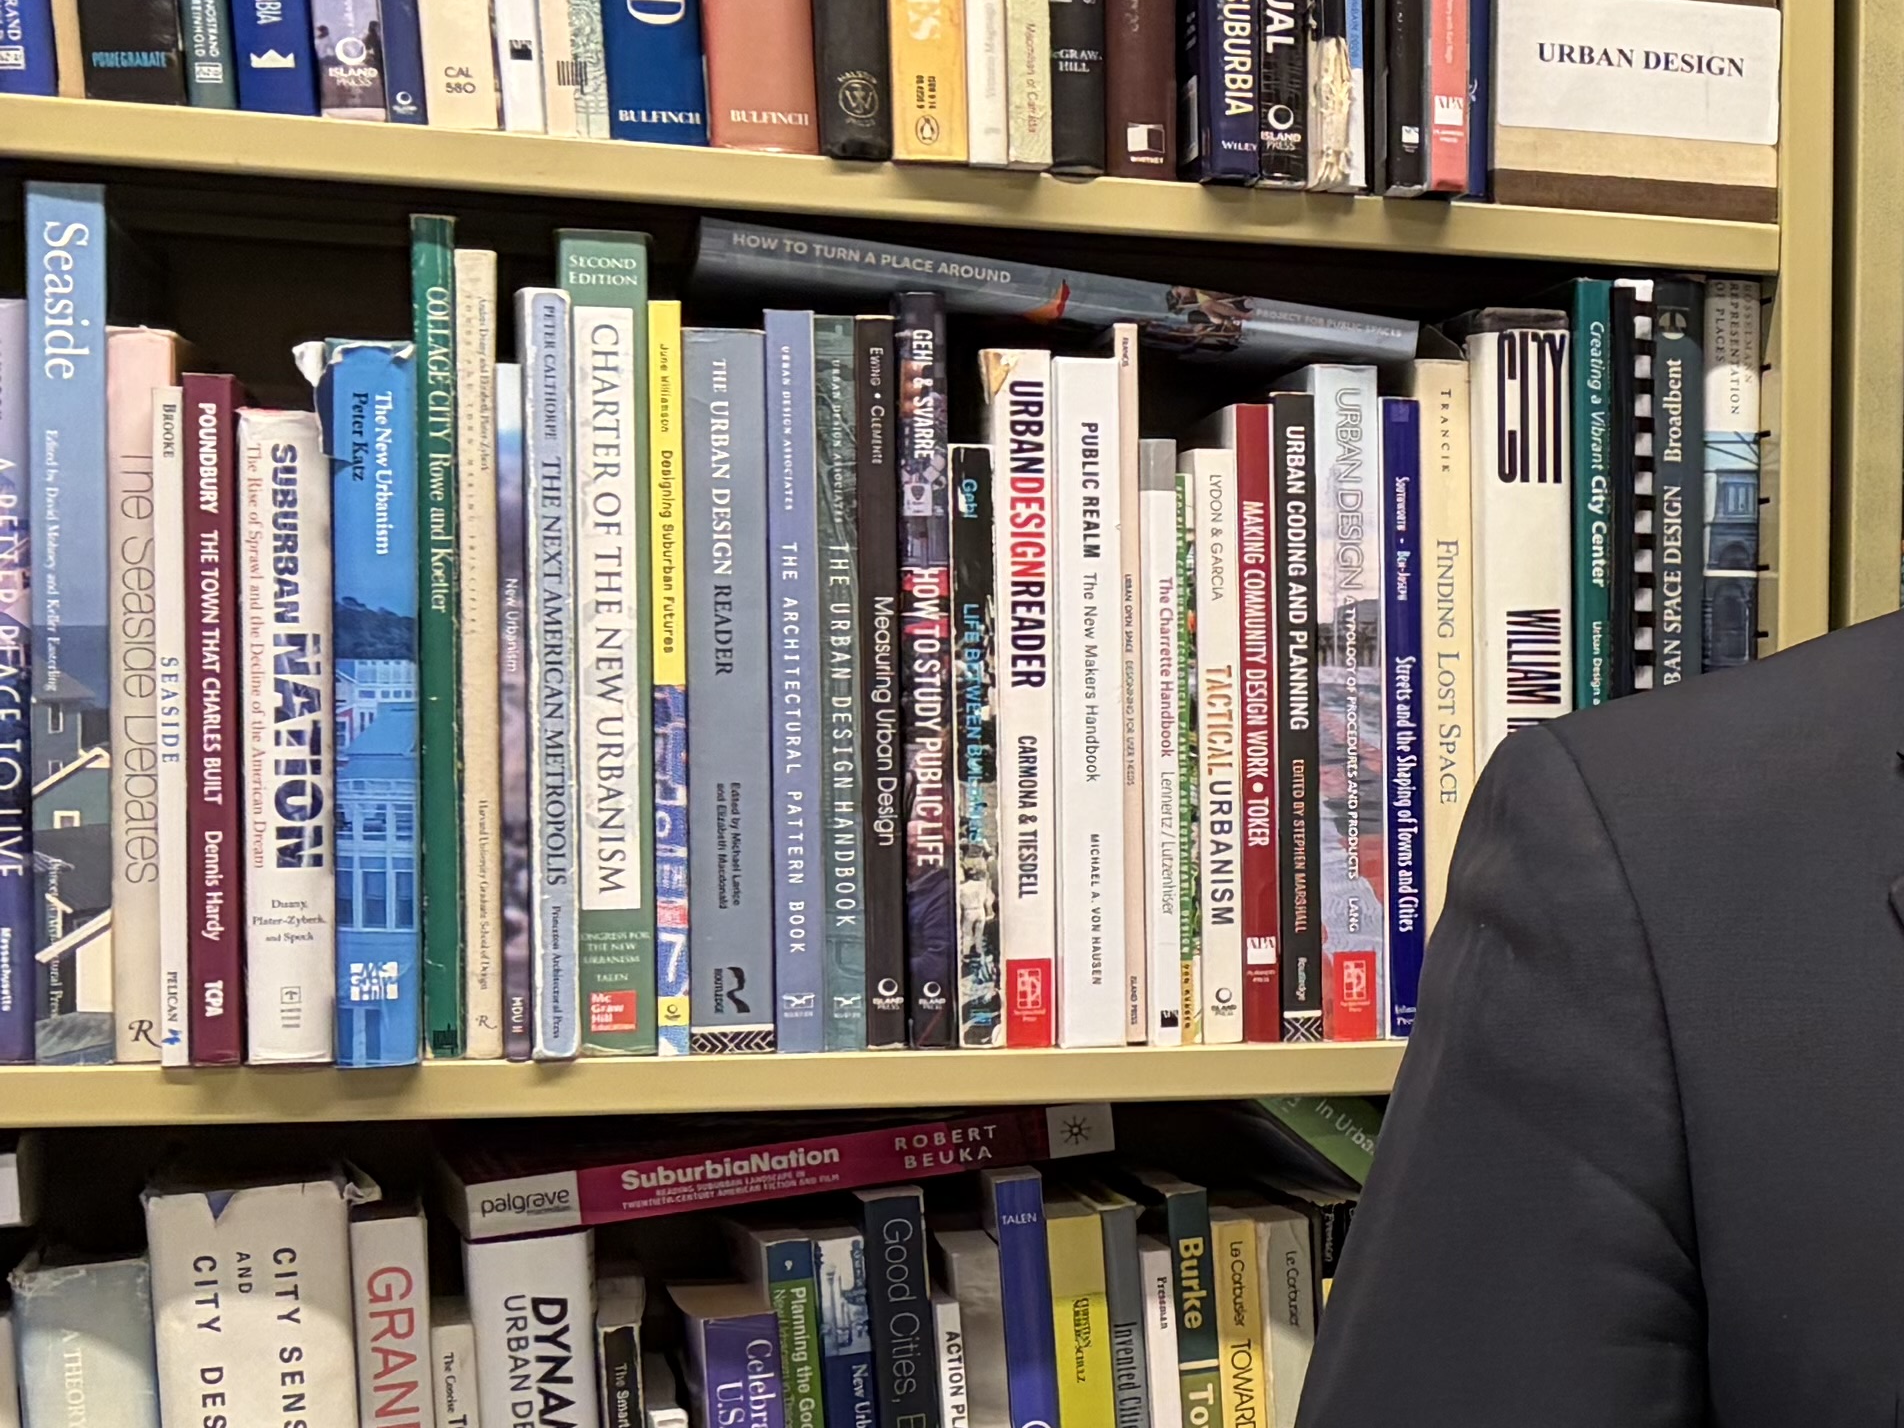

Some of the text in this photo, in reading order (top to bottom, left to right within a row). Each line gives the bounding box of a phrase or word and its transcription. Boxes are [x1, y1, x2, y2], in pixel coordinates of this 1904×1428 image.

[1538, 44, 1745, 78] URBAN DESIGN
[733, 232, 1011, 284] HOW TO TURN A PLACE AROUND
[42, 219, 91, 382] Seaside
[1497, 332, 1565, 483] CITY
[590, 323, 628, 896] CHARTER OF THE NEW URBANISM
[270, 442, 322, 870] SUBURBAN NATION
[1205, 662, 1234, 927] TACTICAL URBANISM
[620, 1146, 841, 1192] SuburbiaNation
[895, 1123, 997, 1151] ROBERT
[902, 1144, 992, 1170] BEUKA
[481, 1188, 570, 1219] palgrave
[193, 1254, 221, 1336] CITY
[236, 1250, 251, 1294] AND
[273, 1246, 300, 1326] CITY
